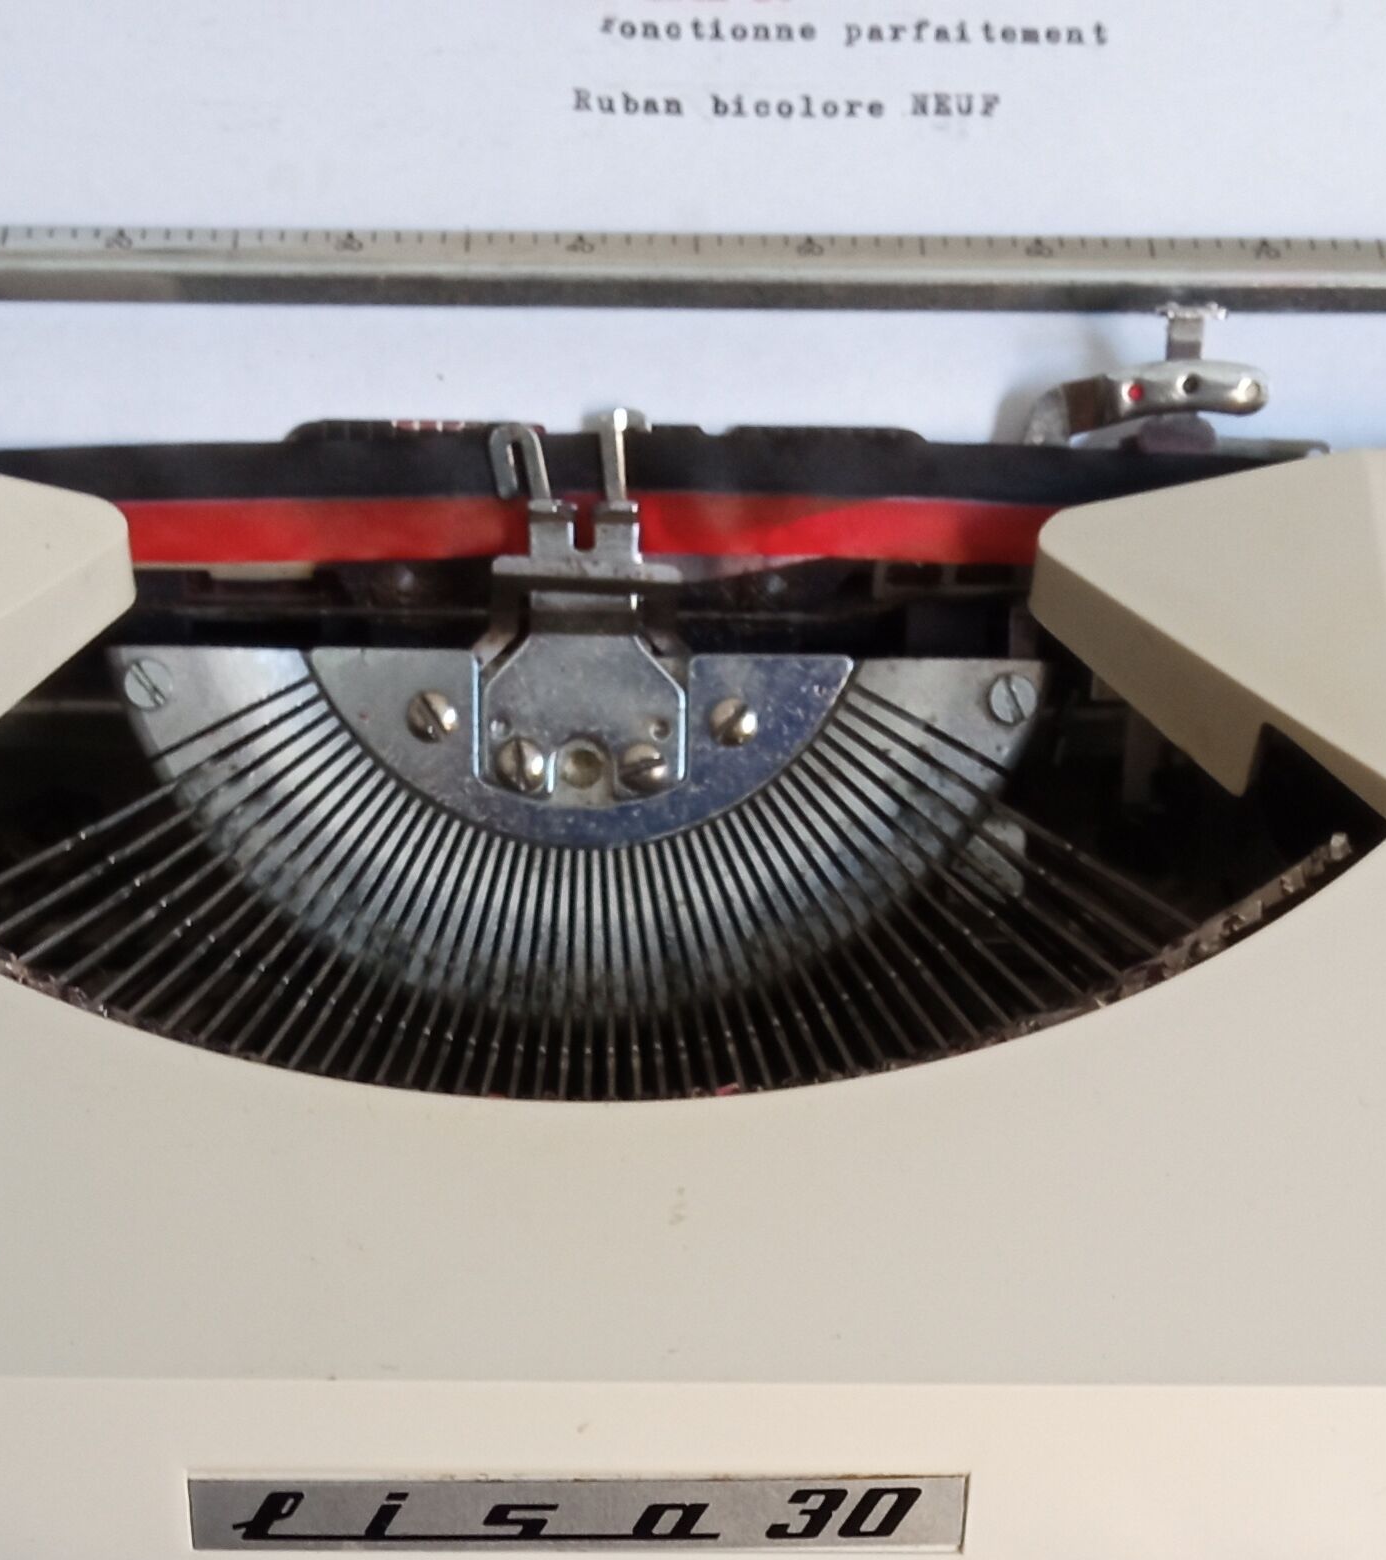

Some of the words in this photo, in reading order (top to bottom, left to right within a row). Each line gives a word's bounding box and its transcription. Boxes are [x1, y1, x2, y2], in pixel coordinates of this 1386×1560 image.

[844, 19, 1108, 47] parfaitement
[572, 87, 684, 116] Ruban
[711, 94, 885, 118] bicolore
[910, 92, 1001, 117] NEUF
[232, 1491, 720, 1540] lisa
[765, 1487, 922, 1539] 30
